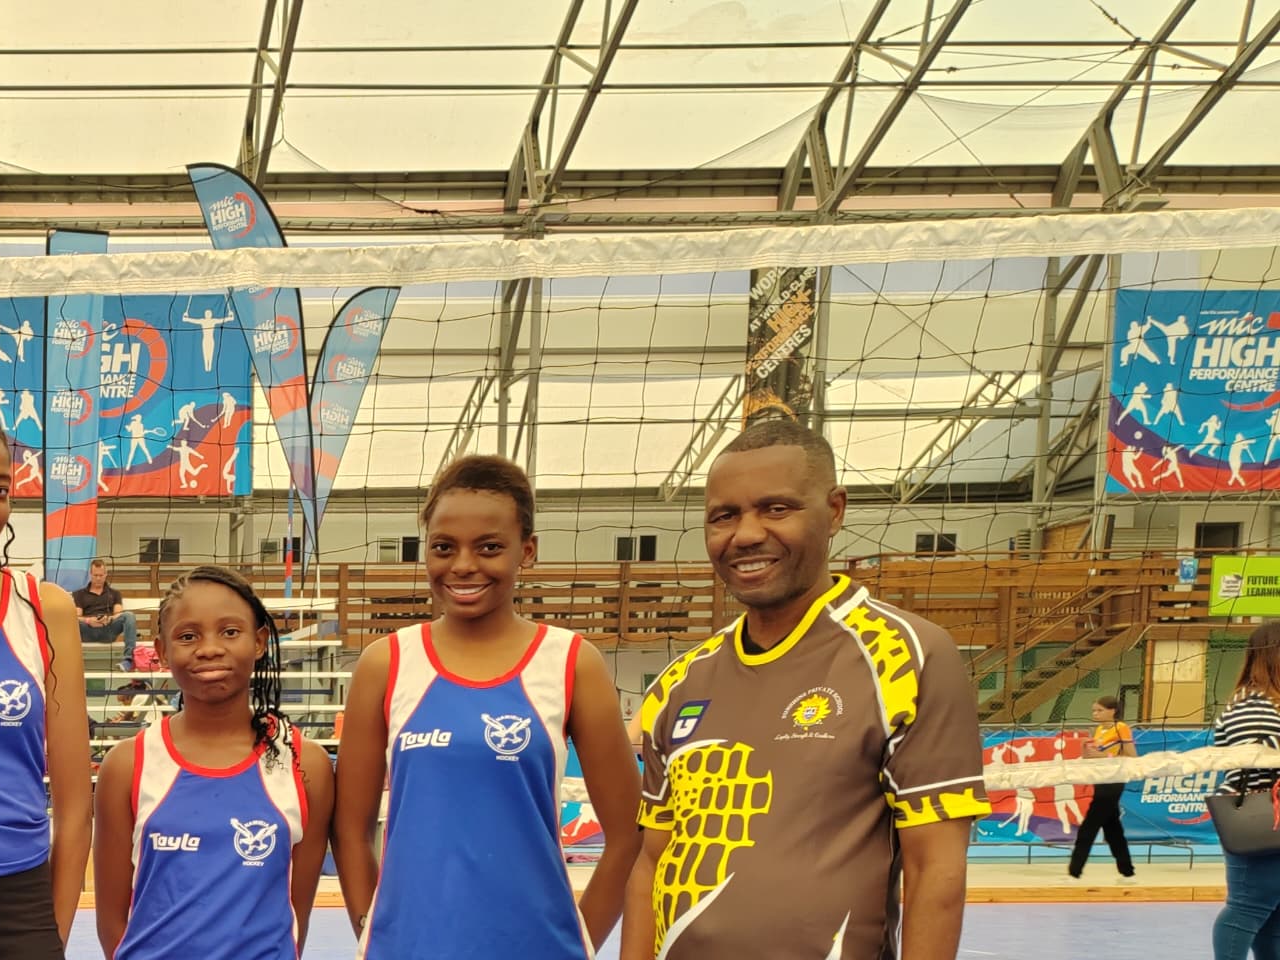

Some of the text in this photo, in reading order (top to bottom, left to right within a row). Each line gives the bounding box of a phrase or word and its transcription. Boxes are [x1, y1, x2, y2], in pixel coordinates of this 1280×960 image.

[210, 202, 247, 226] HIGH
[756, 324, 812, 379] CENTRES
[1191, 336, 1280, 368] HIGH
[1188, 367, 1279, 380] PERFORMANCE
[1224, 379, 1277, 393] CENTRE
[51, 395, 84, 409] HIGH
[50, 463, 84, 476] HIGH
[1246, 587, 1280, 597] LEARNIN
[399, 728, 453, 752] Tayla
[1142, 770, 1219, 796] HIGH
[1140, 792, 1207, 804] PERFORMAN
[148, 832, 201, 852] Tayla
